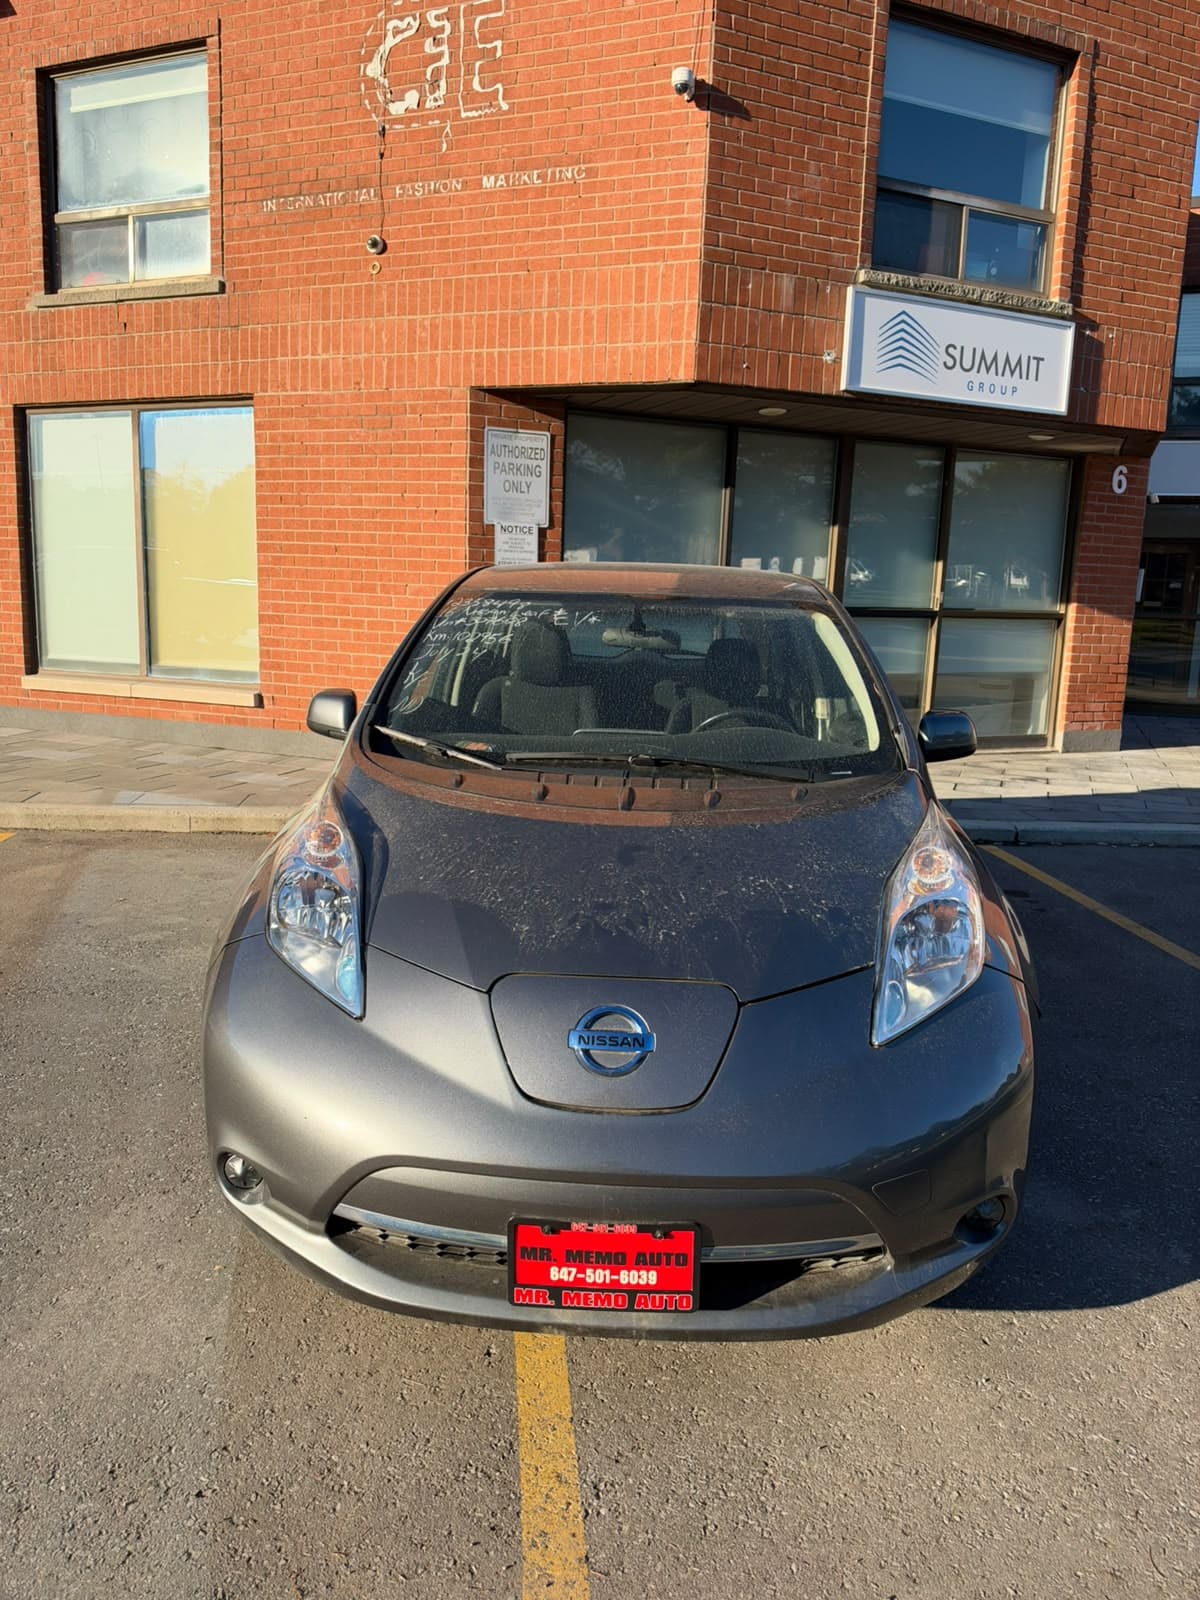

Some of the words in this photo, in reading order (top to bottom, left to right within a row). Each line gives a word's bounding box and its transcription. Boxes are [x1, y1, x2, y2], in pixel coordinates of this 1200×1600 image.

[262, 187, 378, 212] INERNATIONAL
[395, 178, 463, 198] FASHION
[482, 166, 586, 189] MARKETING
[942, 343, 1045, 382] SUMMIT
[966, 380, 1019, 397] GROUP
[490, 444, 546, 461] AUTHORIZED
[493, 462, 542, 478] PARKING
[503, 480, 532, 494] ONLY
[1111, 465, 1128, 494] 6
[500, 525, 534, 535] NOTICE
[578, 1034, 645, 1048] NISSAN
[520, 1247, 557, 1262] MR.
[565, 1249, 627, 1266] MEMO
[634, 1252, 689, 1267] AUTO
[549, 1266, 658, 1285] 647-501-6039
[513, 1287, 555, 1305] MR.
[562, 1290, 628, 1309] MEMO
[634, 1293, 693, 1311] AUTO
